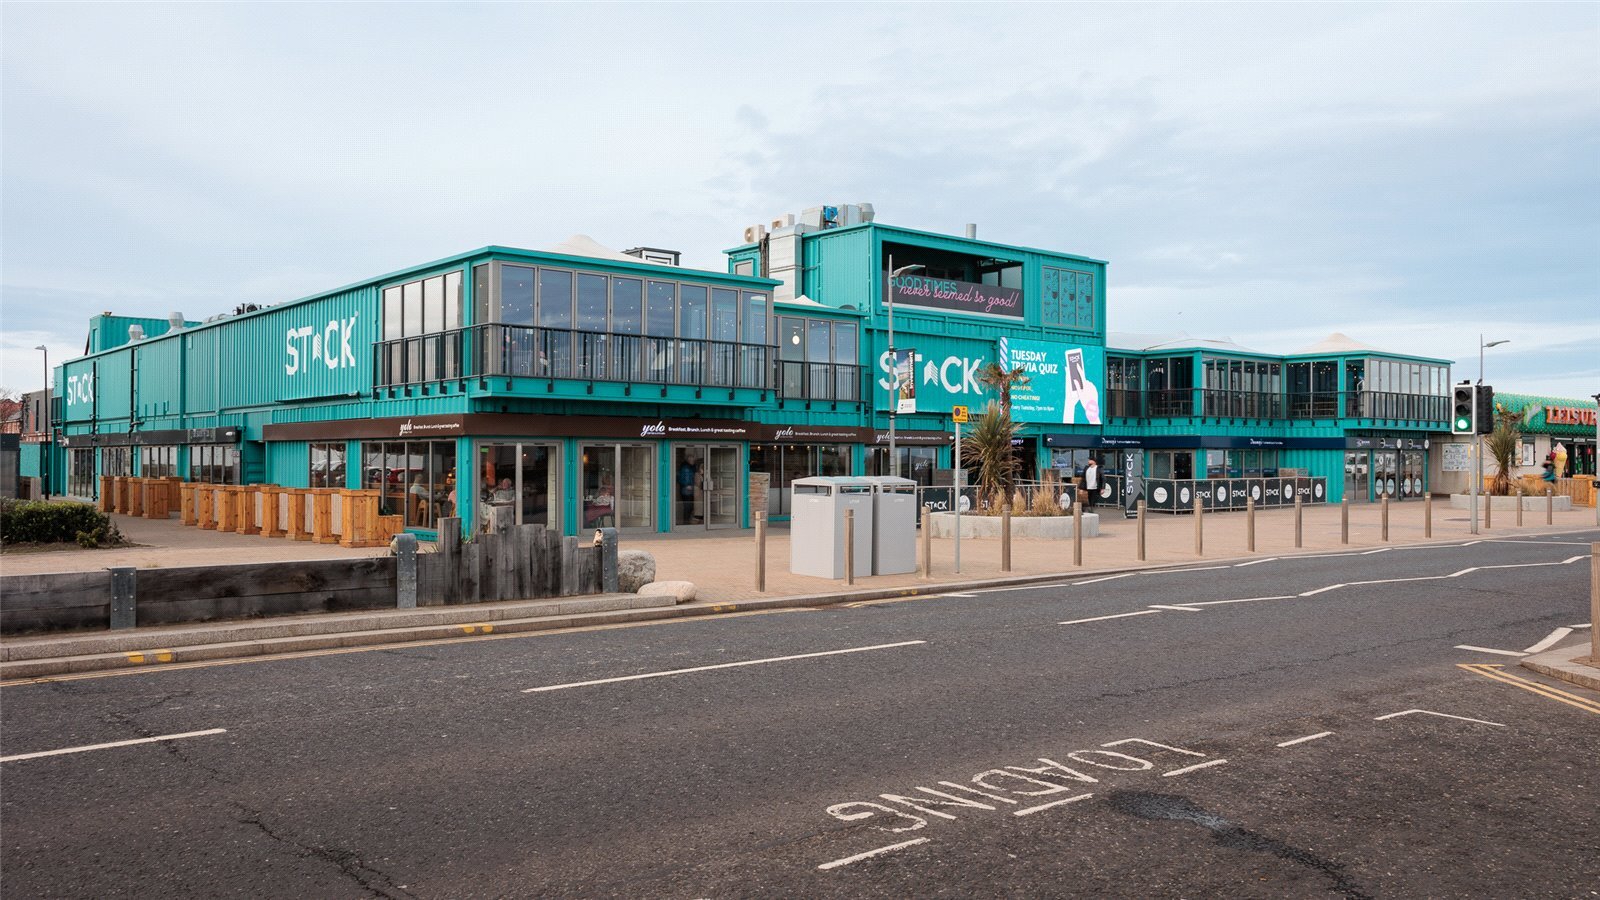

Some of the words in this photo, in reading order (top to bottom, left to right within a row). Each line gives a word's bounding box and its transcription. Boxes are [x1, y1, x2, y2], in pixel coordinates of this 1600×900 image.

[924, 279, 957, 293] TIMES
[899, 284, 931, 297] never
[933, 285, 972, 302] seemed
[974, 289, 985, 303] so
[986, 291, 1019, 312] good!
[1011, 350, 1047, 362] TUESDAY
[878, 351, 983, 395] SACK
[1039, 363, 1058, 375] QUIZ
[640, 421, 666, 437] yolo
[775, 426, 793, 440] yolo
[1126, 453, 1134, 494] STACK
[924, 500, 948, 510] STACK
[826, 738, 1206, 833] LOADING
